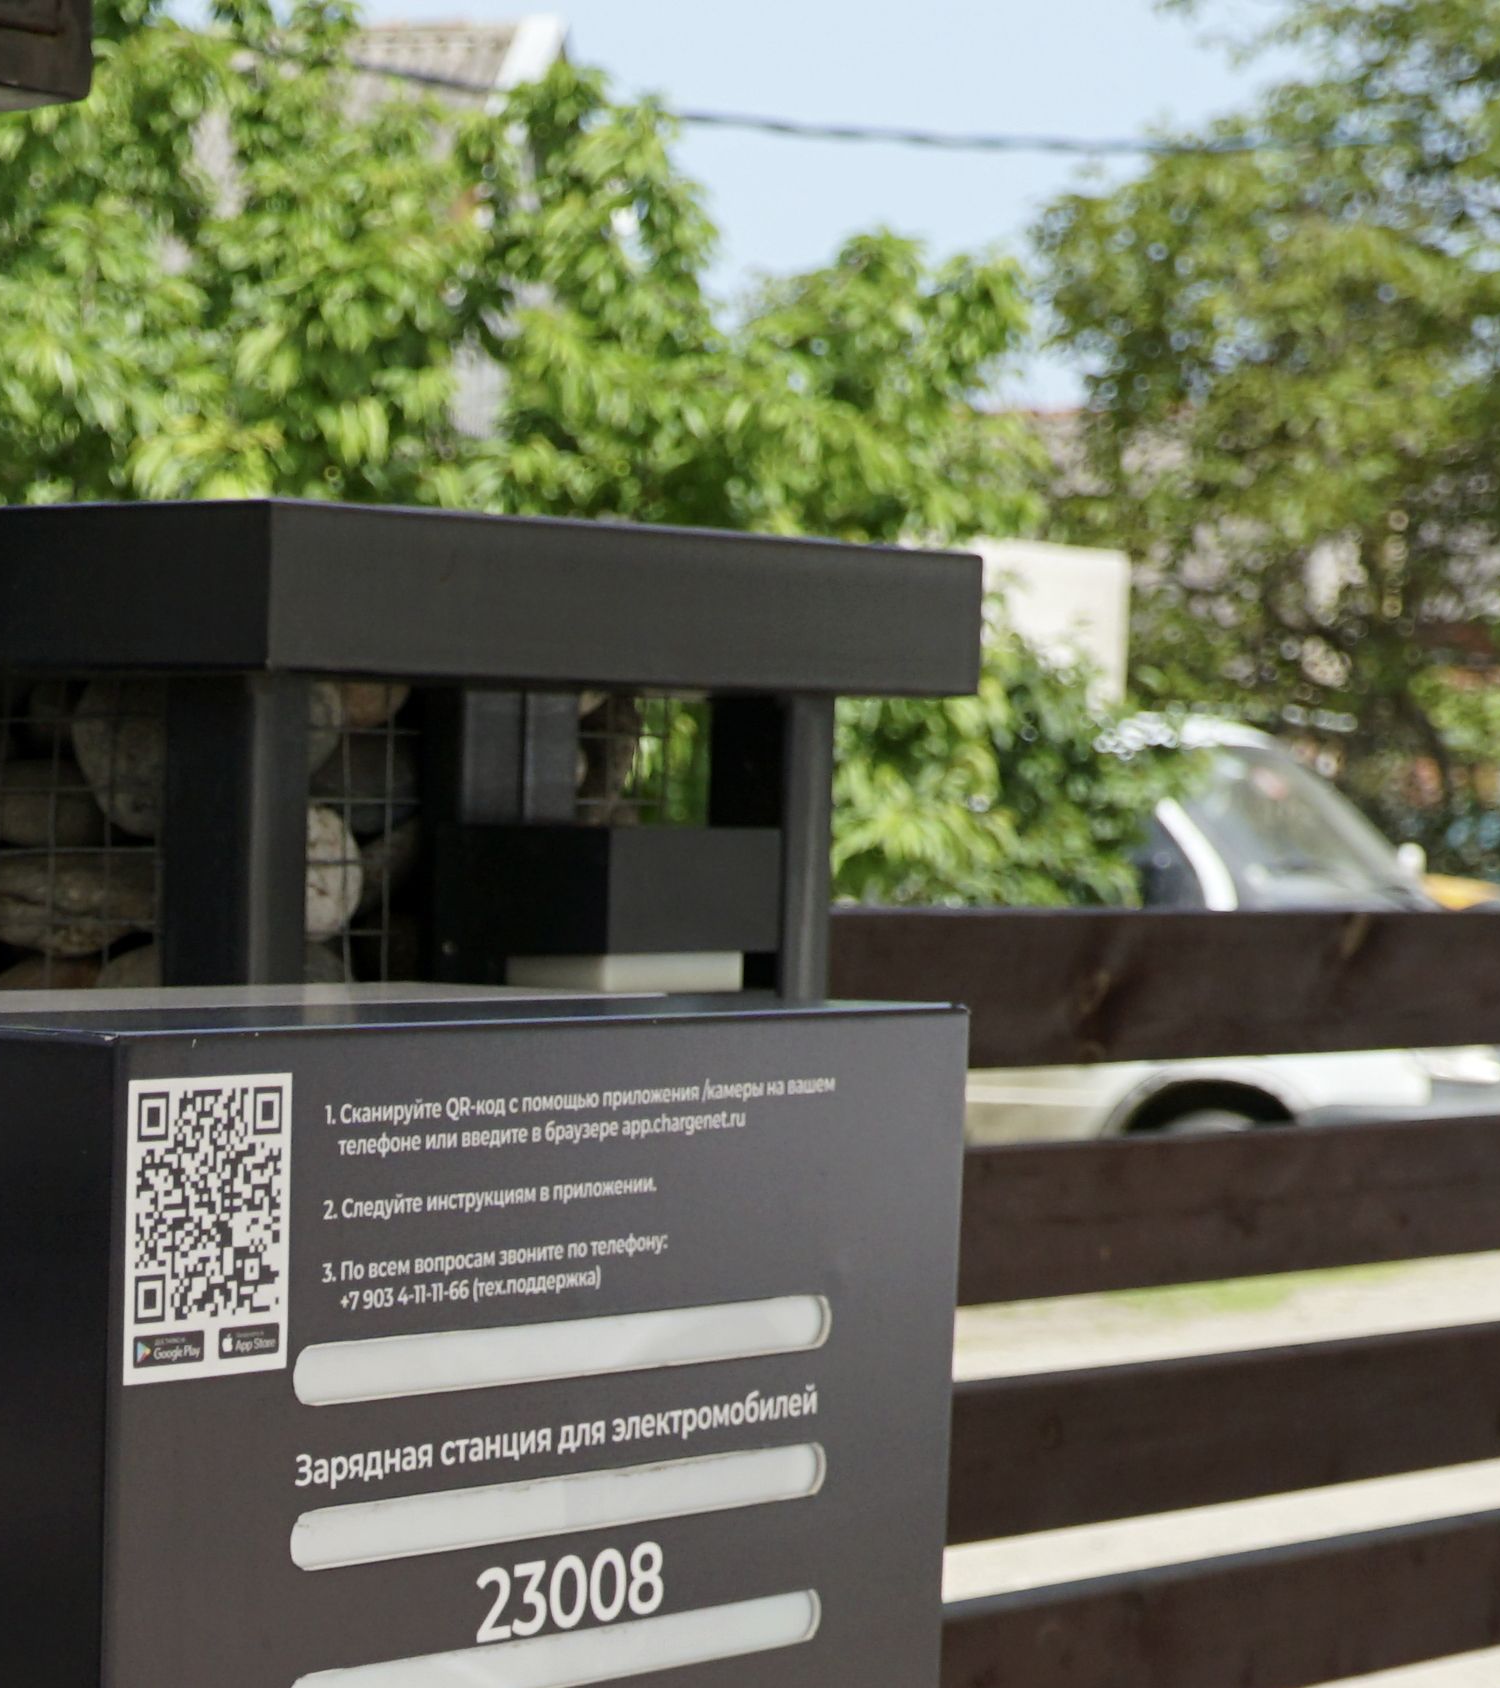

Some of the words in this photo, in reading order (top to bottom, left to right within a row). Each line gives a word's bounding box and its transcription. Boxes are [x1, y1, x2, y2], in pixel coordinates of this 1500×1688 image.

[325, 1105, 336, 1124] 1.
[340, 1099, 442, 1125] Сканируйте
[446, 1097, 506, 1121] QR-код
[509, 1098, 518, 1113] с
[522, 1093, 599, 1112] помощью
[603, 1085, 700, 1111] приложения
[767, 1080, 784, 1096] на
[787, 1077, 836, 1095] вашем
[338, 1132, 421, 1157] телефоне
[426, 1133, 457, 1149] или
[462, 1128, 528, 1148] введите
[532, 1127, 541, 1142] в
[545, 1120, 619, 1144] браузере
[622, 1111, 746, 1139] app.chargenet.ru
[324, 1200, 337, 1220] 2.
[342, 1194, 423, 1220] Следуйте
[427, 1188, 536, 1212] инструкциям
[540, 1186, 550, 1201] в
[553, 1177, 657, 1204] приложении.
[322, 1263, 336, 1283] 3.
[341, 1261, 364, 1280] По
[369, 1260, 410, 1278] всем
[415, 1251, 495, 1275] вопросам
[499, 1243, 564, 1262] звоните
[568, 1242, 588, 1258] по
[590, 1233, 668, 1256] телефону:
[341, 1291, 359, 1310] +7
[363, 1288, 394, 1309] 903
[397, 1280, 469, 1305] 4-11-11-66
[473, 1265, 601, 1301] (тех.поддержка)
[153, 1345, 183, 1362] Google
[184, 1345, 201, 1359] Play
[235, 1340, 253, 1353] App
[254, 1338, 276, 1350] Store
[295, 1444, 433, 1489] Зарядная
[441, 1428, 551, 1465] станция
[558, 1421, 605, 1454] для
[612, 1384, 817, 1441] электромобилей
[476, 1542, 664, 1643] 23008
